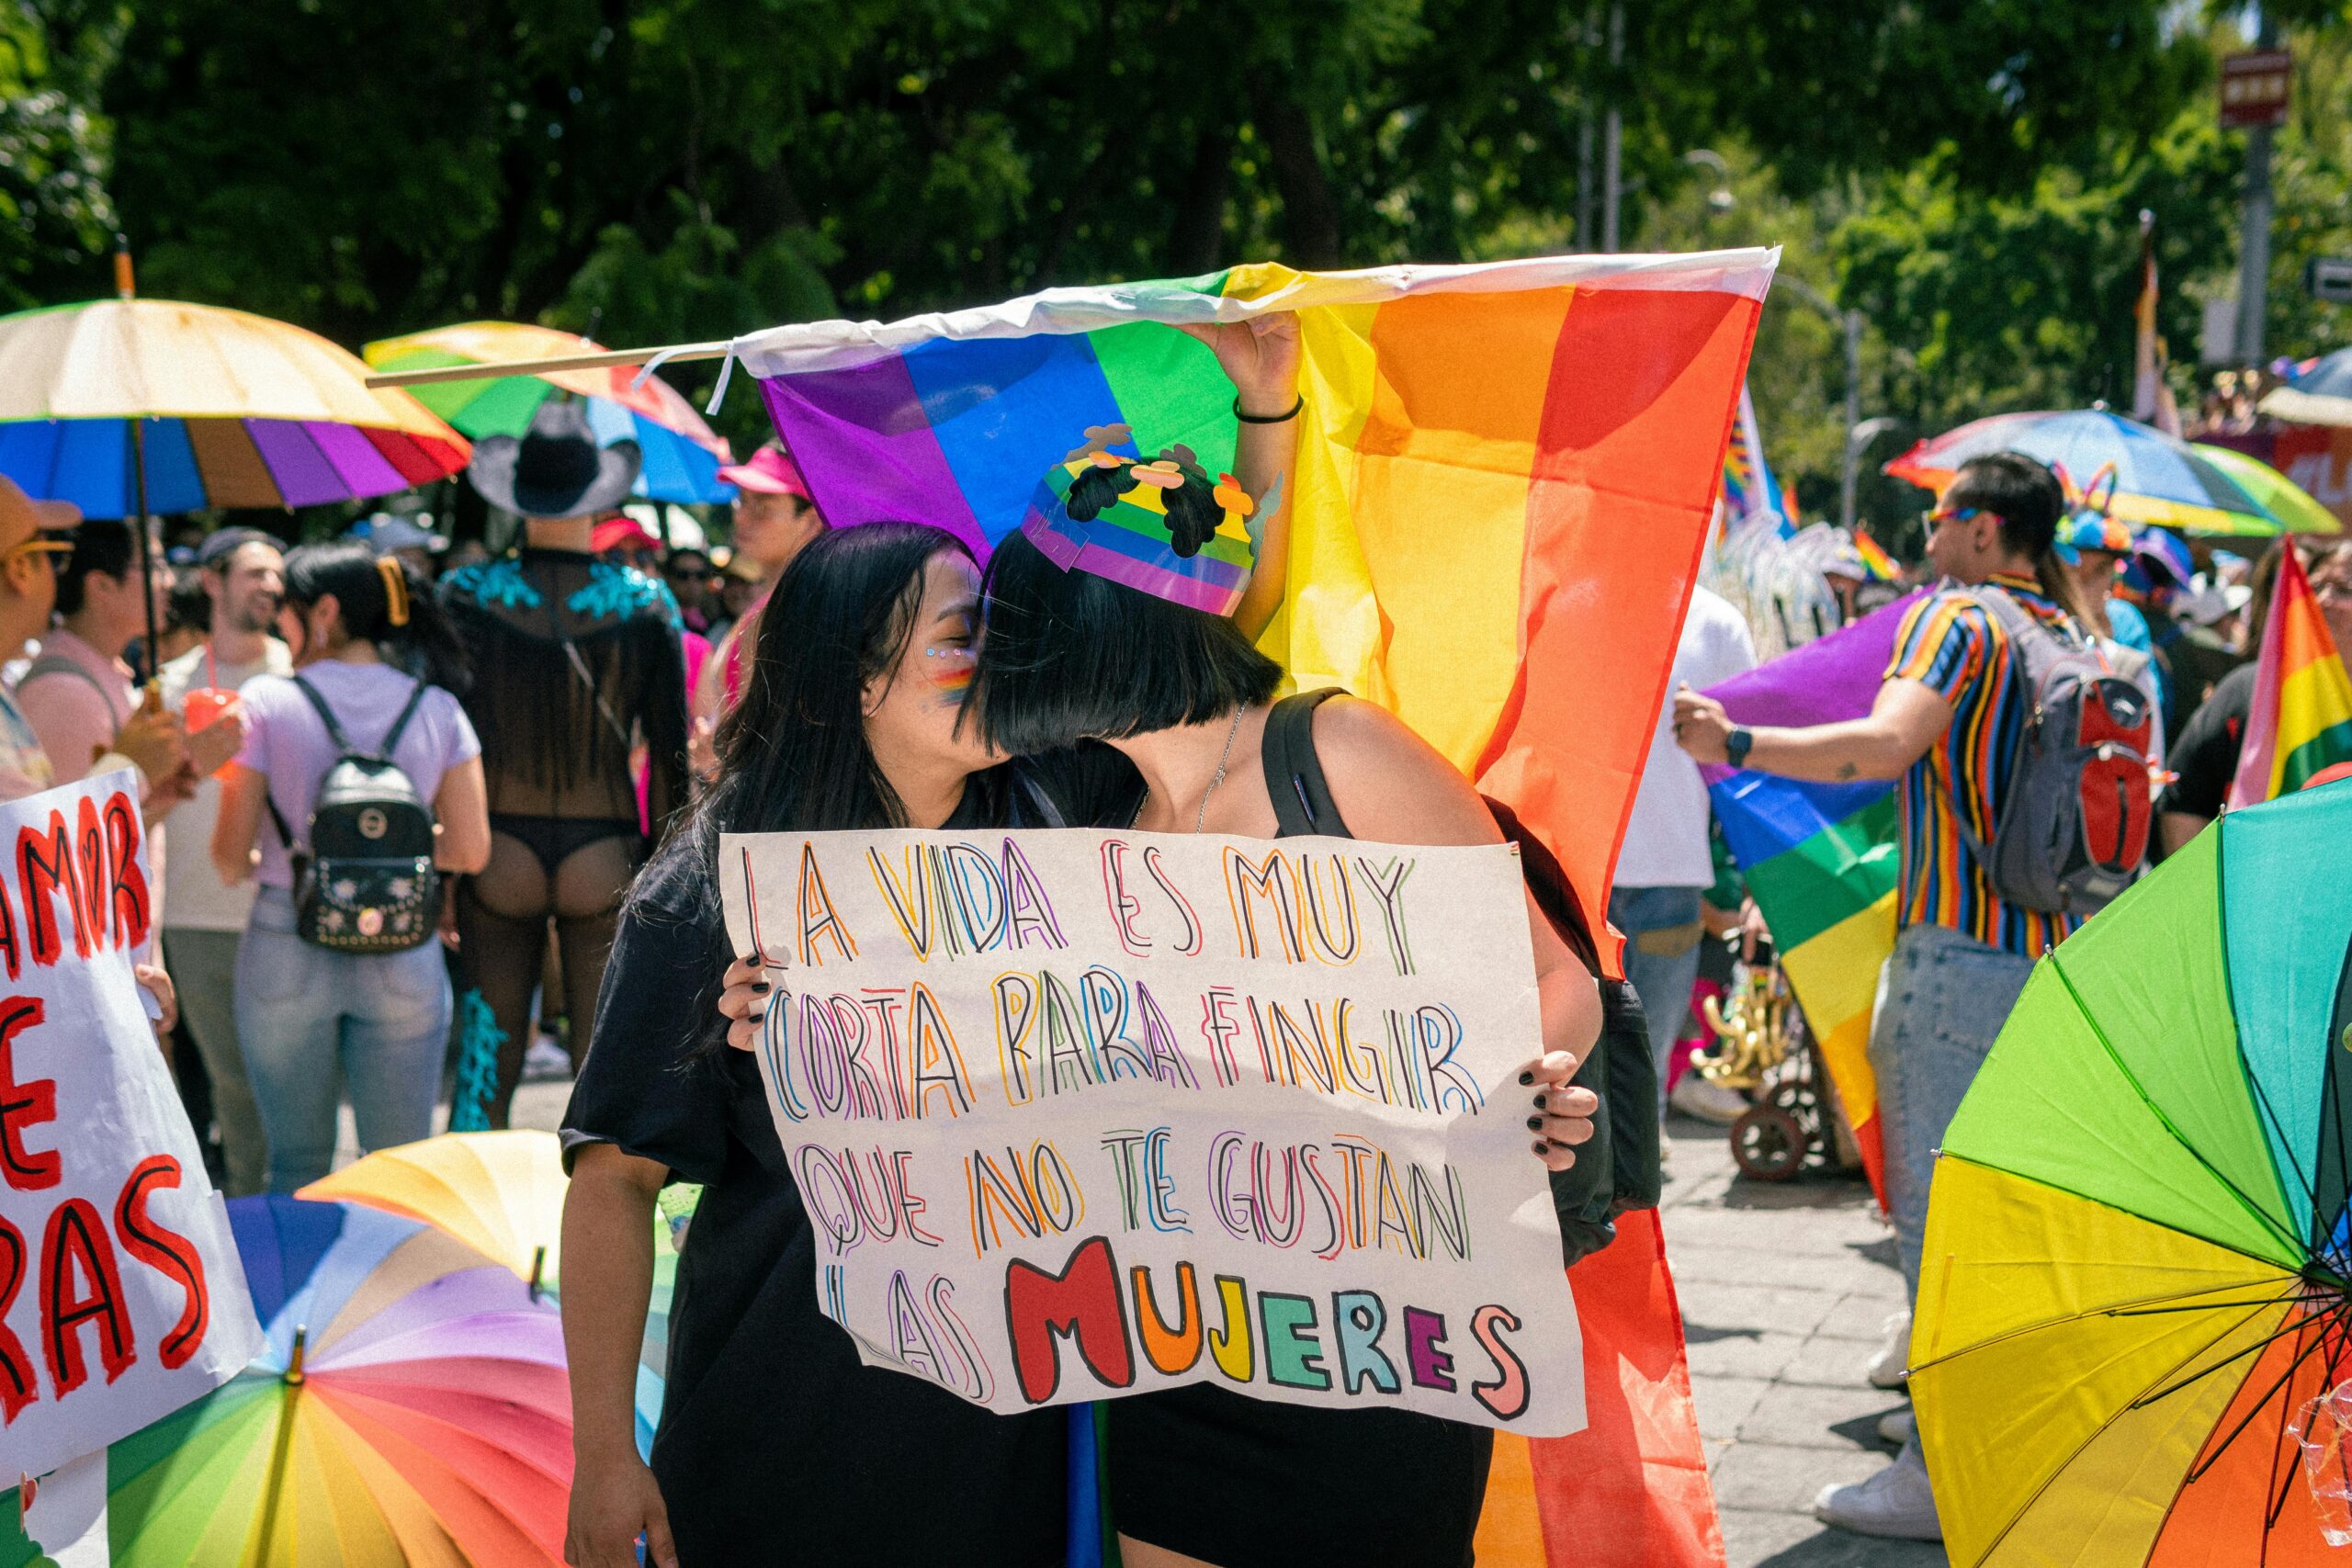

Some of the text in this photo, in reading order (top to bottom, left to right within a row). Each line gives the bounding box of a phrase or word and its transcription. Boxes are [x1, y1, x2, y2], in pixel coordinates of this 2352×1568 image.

[742, 837, 1416, 976] LA VIDA ES MUY
[764, 964, 1485, 1122] CORTA PARA FINGIR
[794, 1127, 1472, 1261] QUE NO TE GUSTAN
[826, 1235, 1532, 1420] LAS MUJERES
